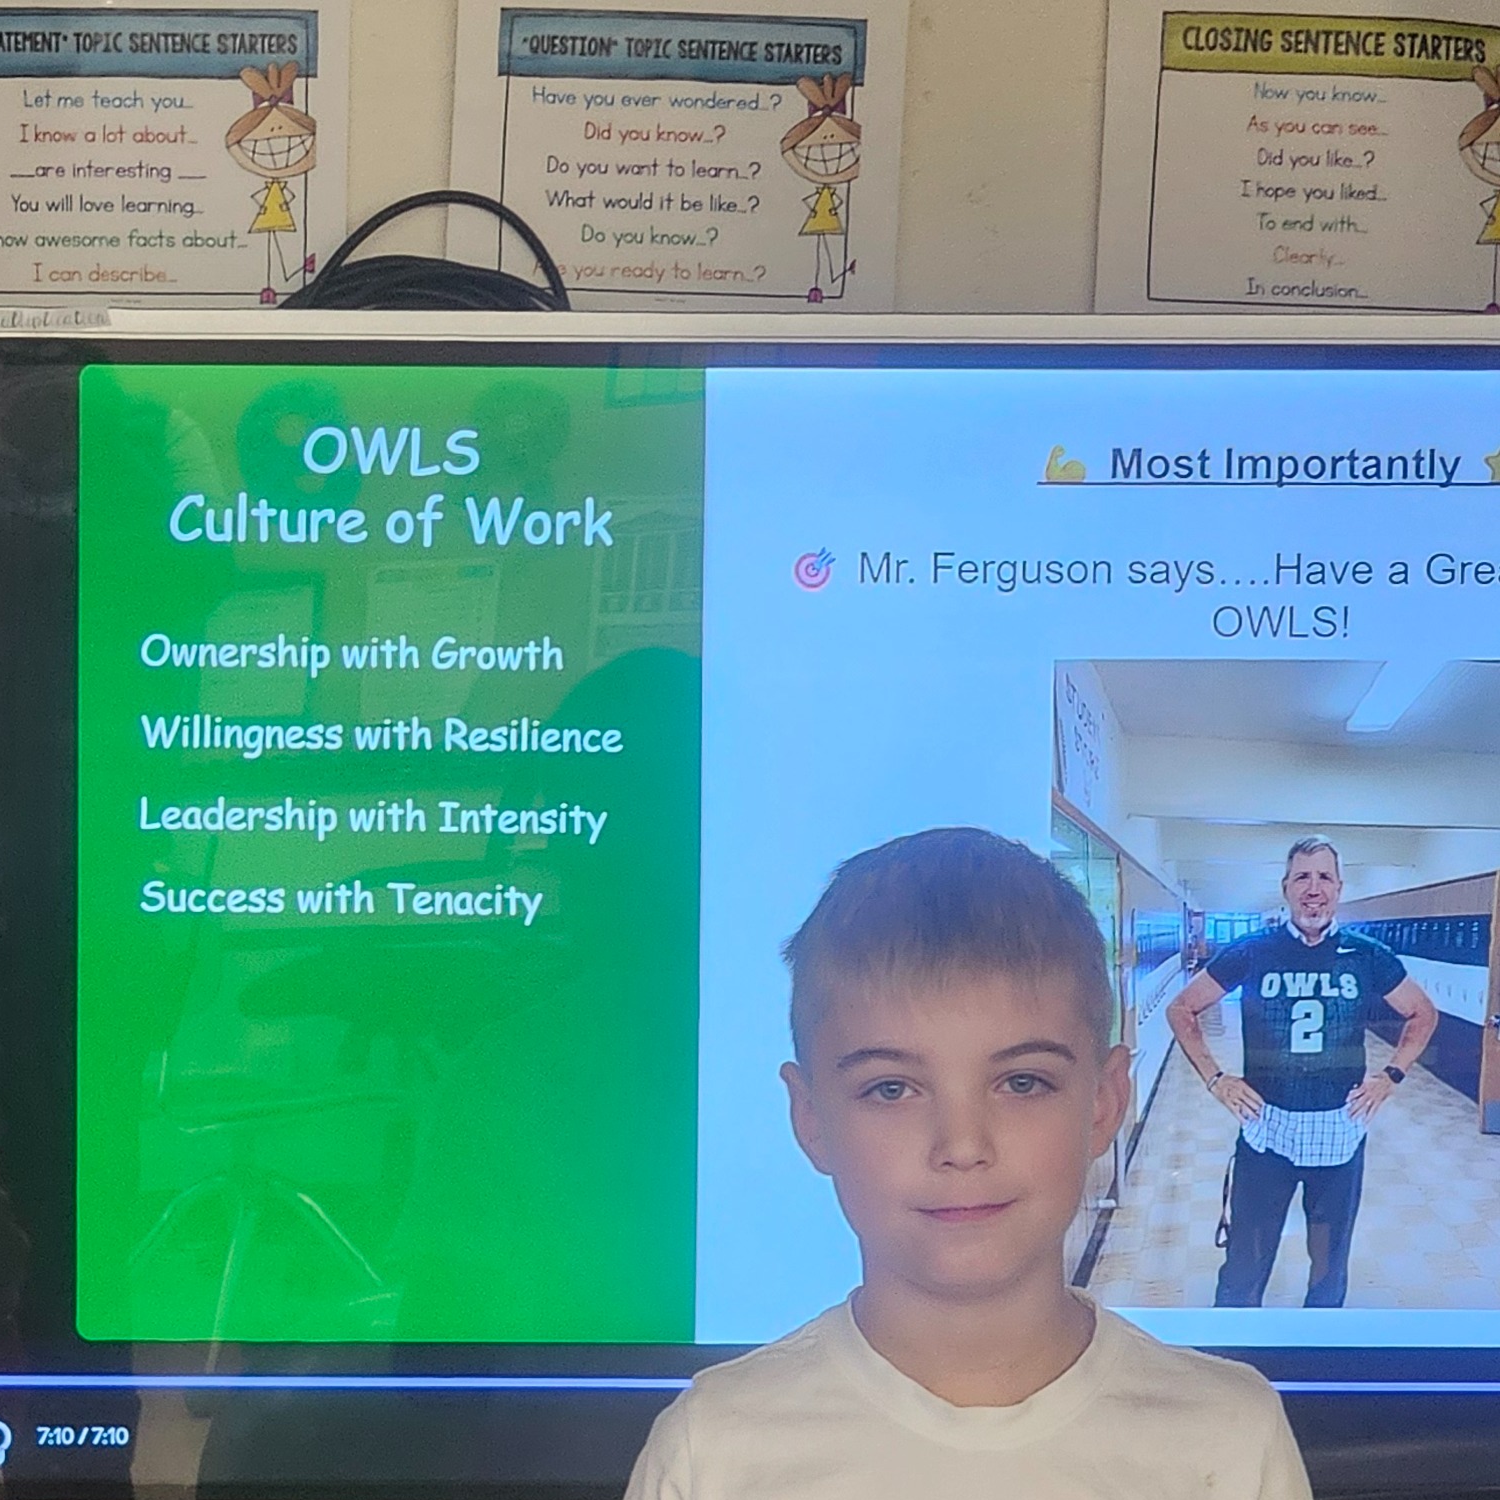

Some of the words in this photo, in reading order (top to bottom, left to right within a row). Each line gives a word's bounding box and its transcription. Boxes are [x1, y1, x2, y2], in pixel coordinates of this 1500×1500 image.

[74, 33, 121, 54] TOPIC
[129, 34, 210, 55] SENTENCE
[217, 34, 298, 56] STARTERS
[626, 38, 672, 59] TOPIC
[678, 39, 758, 62] SENTENCE
[765, 41, 843, 65] STARTERS
[1182, 26, 1273, 53] CLOSING
[1280, 30, 1386, 57] SENTENCE
[1393, 34, 1486, 64] STARTERS
[23, 90, 52, 108] Let
[57, 96, 84, 108] me
[91, 91, 144, 109] teach
[532, 86, 576, 106] Have
[583, 92, 615, 110] you
[621, 95, 661, 108] ever
[1254, 83, 1289, 100] Now
[1295, 88, 1326, 105] you
[20, 125, 29, 142] I
[35, 125, 76, 143] know
[84, 131, 96, 143] a
[102, 125, 124, 143] lot
[584, 122, 612, 141] Did
[618, 128, 650, 146] you
[1247, 115, 1270, 133] As
[1275, 121, 1306, 137] you
[1312, 121, 1341, 135] can
[546, 156, 569, 175] Do
[576, 161, 608, 180] you
[615, 162, 658, 177] want
[666, 161, 685, 177] to
[1257, 149, 1283, 166] Did
[1289, 154, 1320, 173] you
[72, 163, 171, 184] interesting
[546, 190, 595, 209] What
[602, 192, 653, 211] would
[659, 193, 673, 211] it
[679, 193, 703, 212] be
[1241, 179, 1251, 197] I
[1257, 183, 1295, 203] hope
[1304, 187, 1334, 204] you
[11, 196, 40, 213] You
[46, 195, 73, 212] will
[80, 195, 114, 213] love
[1257, 212, 1276, 231] To
[1282, 214, 1313, 232] end
[35, 236, 120, 248] awesome
[128, 231, 175, 249] facts
[581, 223, 605, 243] Do
[612, 229, 644, 247] you
[33, 264, 42, 282] I
[49, 269, 82, 282] can
[574, 263, 603, 281] you
[612, 262, 665, 283] ready
[673, 262, 692, 280] to
[1246, 277, 1265, 297] In
[302, 426, 481, 477] OWLS
[1111, 448, 1210, 481] Most
[1225, 447, 1461, 486] Importantly
[169, 493, 368, 543] Culture
[386, 494, 444, 548] of
[465, 495, 614, 548] Work
[859, 551, 916, 584] Mr.
[932, 551, 1112, 593] Ferguson
[1389, 559, 1411, 585] a
[1426, 552, 1500, 586] Gre
[1212, 605, 1350, 640] OWLS!
[141, 633, 330, 678] Ownership
[342, 636, 420, 670] with
[431, 636, 563, 672] Growth
[141, 715, 343, 759] Willingness
[355, 716, 432, 752] with
[444, 718, 624, 754] Resilience
[140, 796, 338, 840] Leadership
[349, 798, 427, 834] with
[439, 801, 608, 845] Intensity
[140, 880, 285, 914] Success
[297, 880, 374, 916] with
[387, 882, 543, 927] Tenacity
[1261, 972, 1359, 999] OWLS
[1291, 999, 1324, 1053] 2
[36, 1426, 75, 1445] 7:10
[91, 1426, 129, 1445] 7:10
